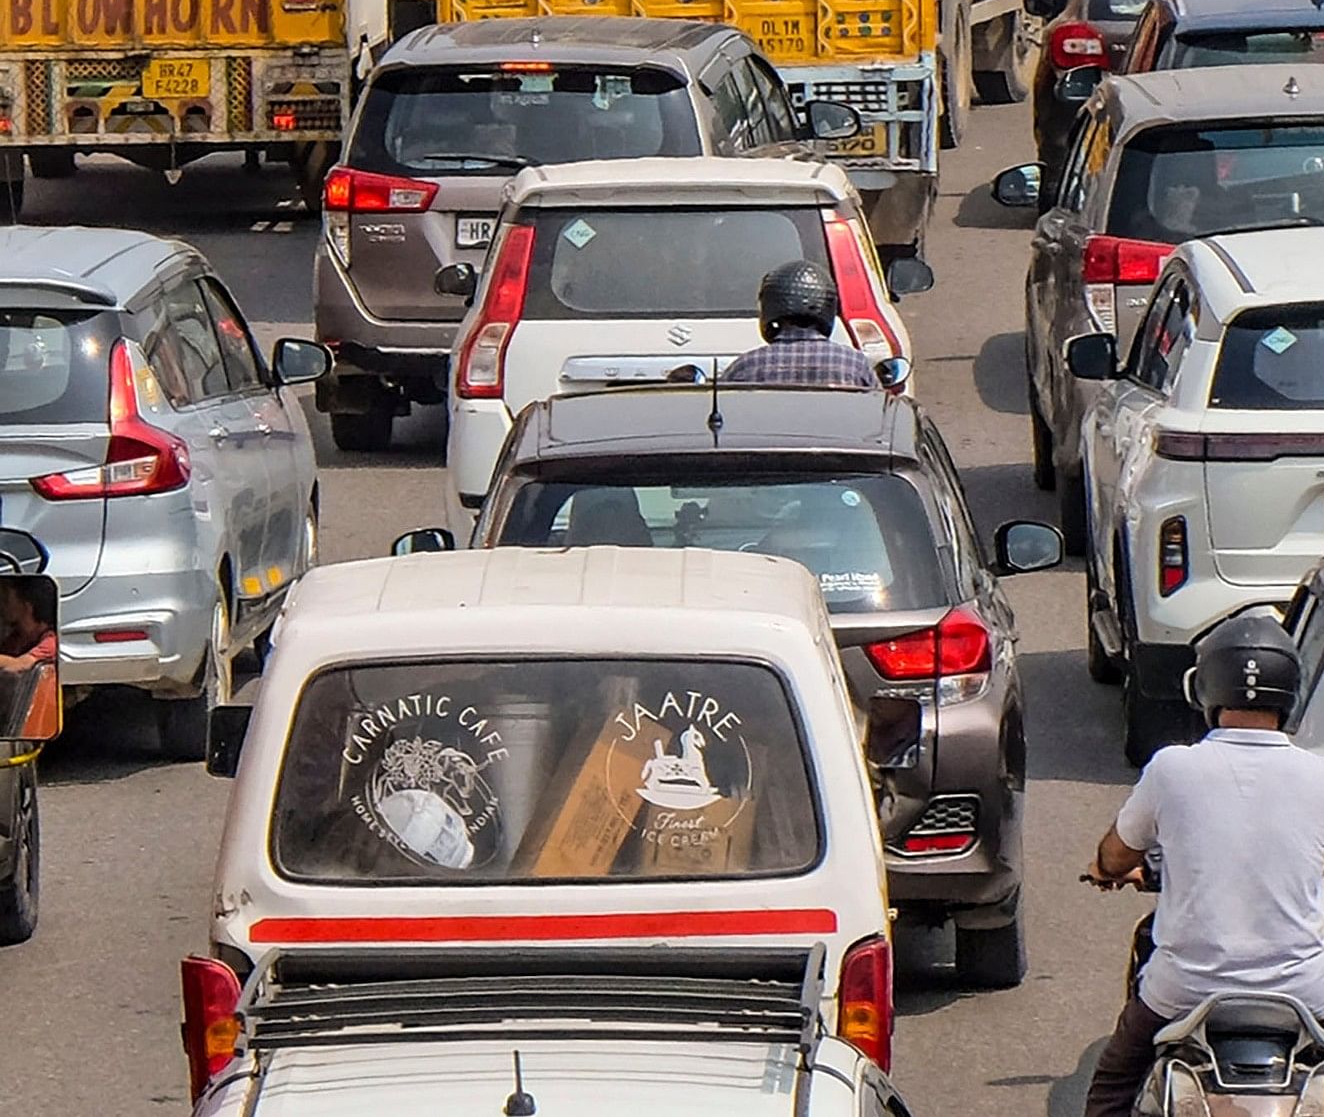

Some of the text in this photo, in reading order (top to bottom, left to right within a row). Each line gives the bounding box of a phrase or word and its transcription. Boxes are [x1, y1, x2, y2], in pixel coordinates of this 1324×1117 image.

[343, 694, 511, 765] CARNATIC CAFE
[615, 691, 743, 742] JAATRE
[654, 812, 706, 830] Finest
